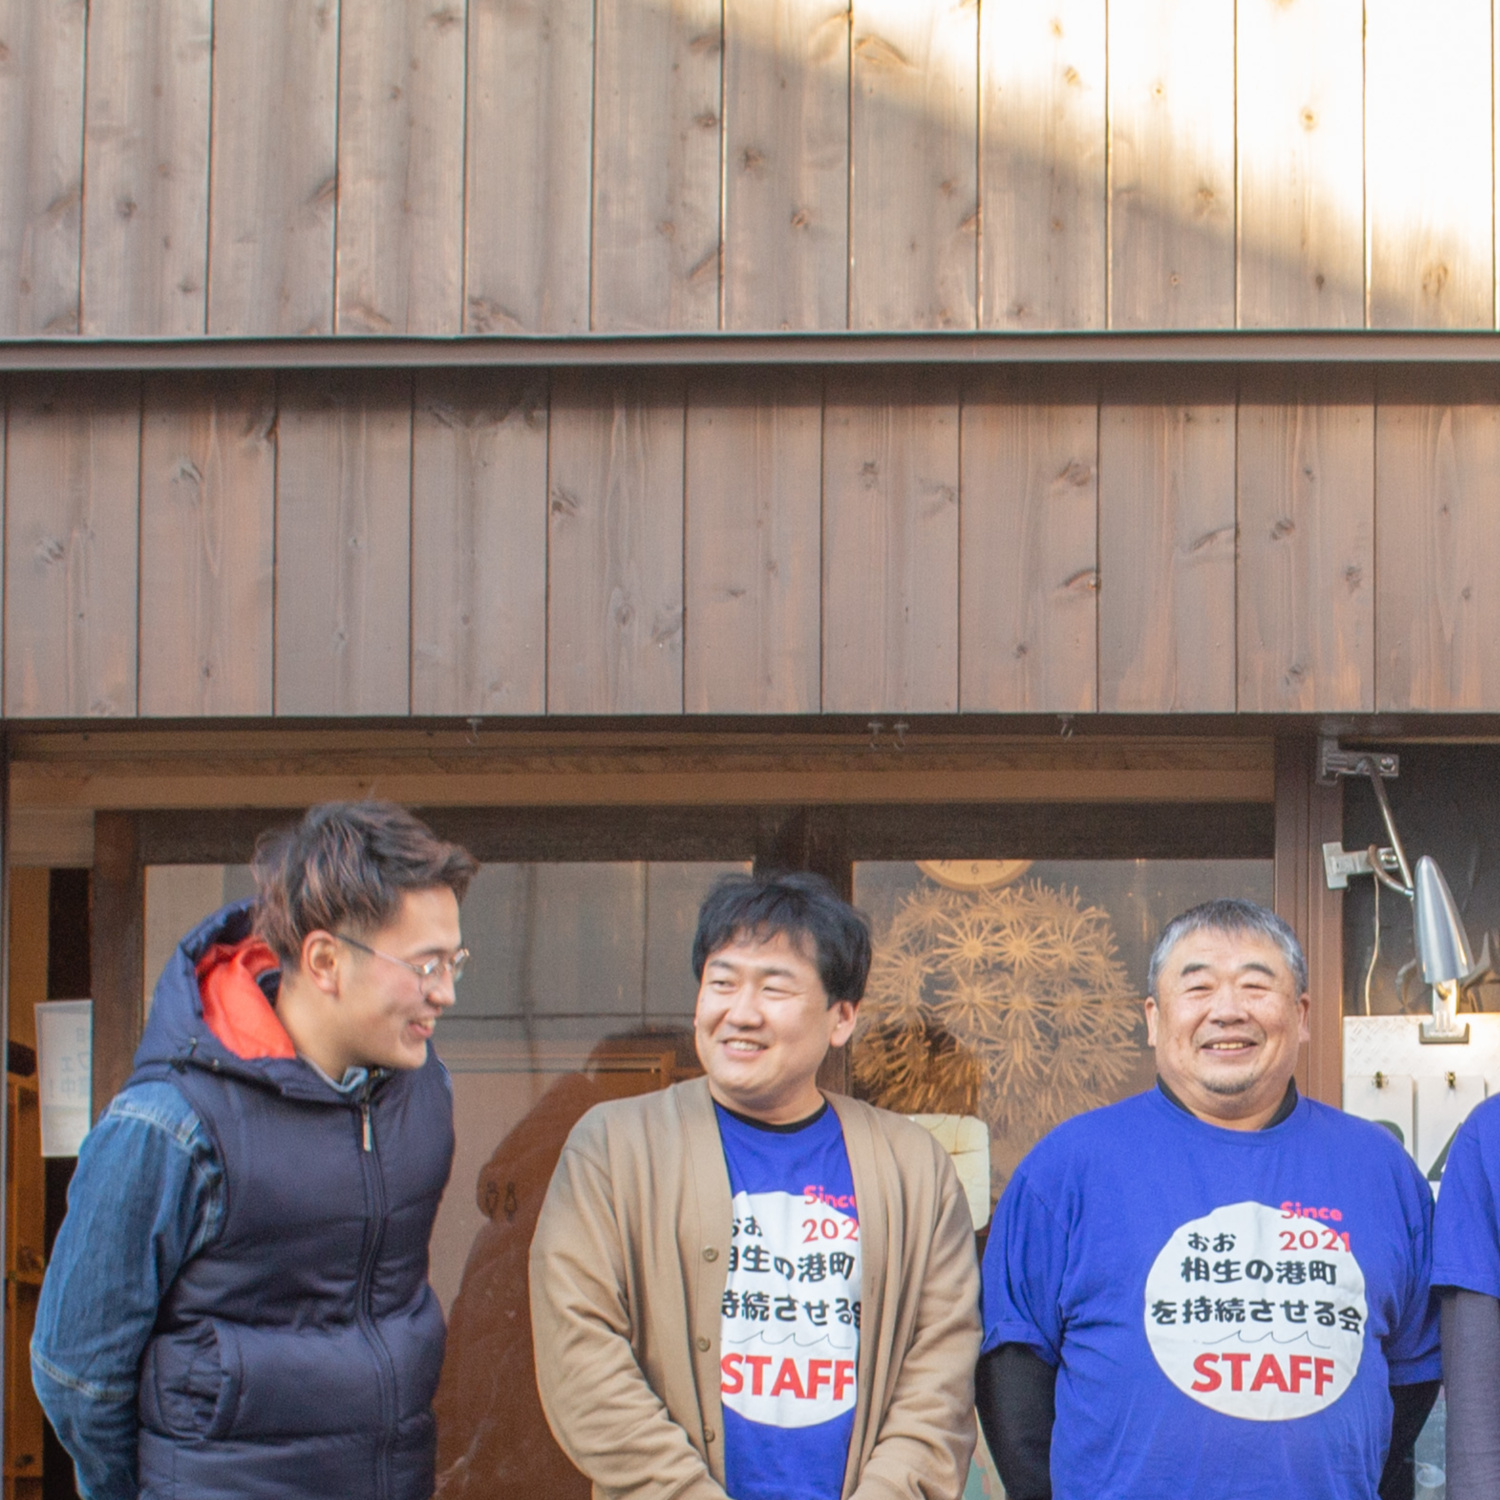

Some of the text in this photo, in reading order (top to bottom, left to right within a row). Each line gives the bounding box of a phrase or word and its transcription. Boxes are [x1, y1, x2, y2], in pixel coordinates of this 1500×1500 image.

[1280, 1201, 1343, 1221] Since
[801, 1218, 859, 1243] 202
[1187, 1232, 1237, 1252] おお
[1279, 1228, 1351, 1253] 2021
[1180, 1256, 1337, 1285] 相生の港町
[721, 1289, 861, 1330] 持続させる
[1151, 1296, 1362, 1335] を持続させる会
[721, 1353, 854, 1401] STAFF
[1190, 1352, 1335, 1397] STAFF
